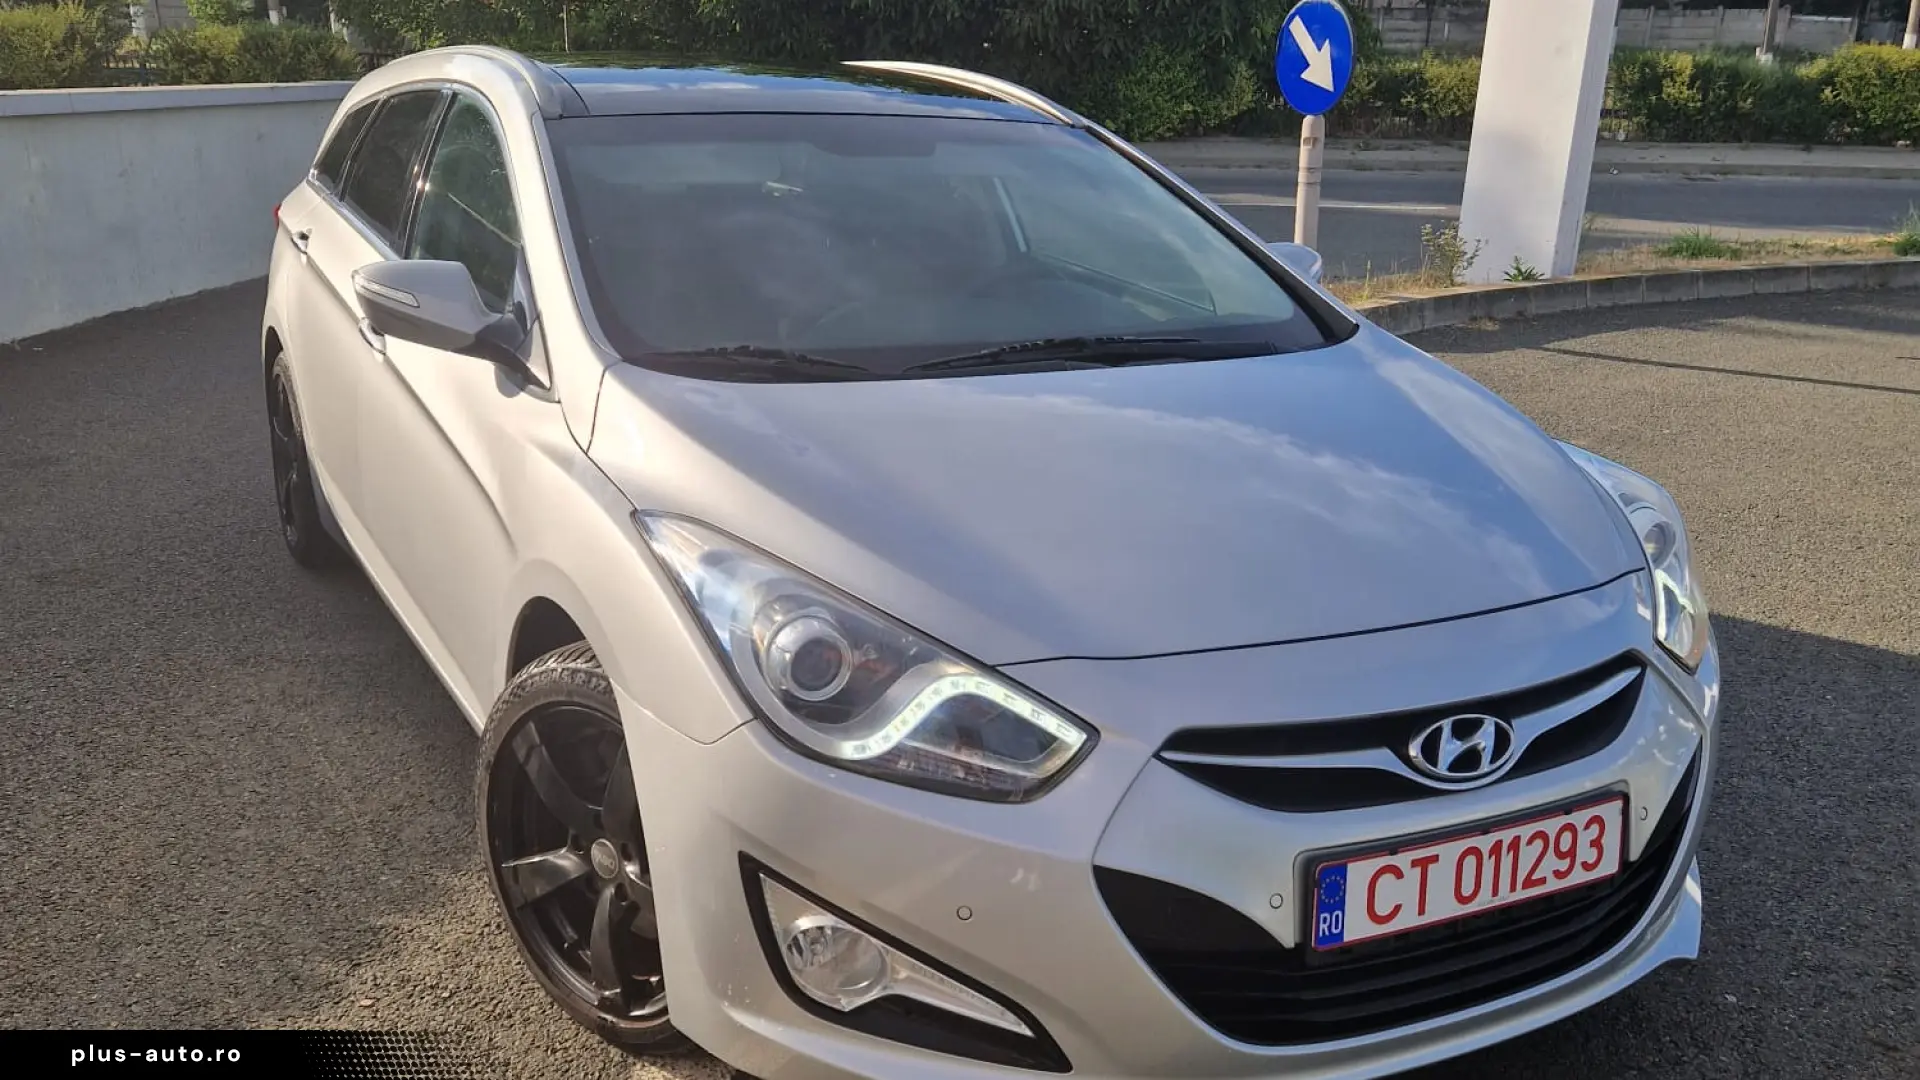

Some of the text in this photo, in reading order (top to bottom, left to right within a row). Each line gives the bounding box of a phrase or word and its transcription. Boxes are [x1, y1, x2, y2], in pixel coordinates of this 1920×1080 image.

[1366, 814, 1606, 925] CT 011293
[1319, 910, 1342, 937] RO
